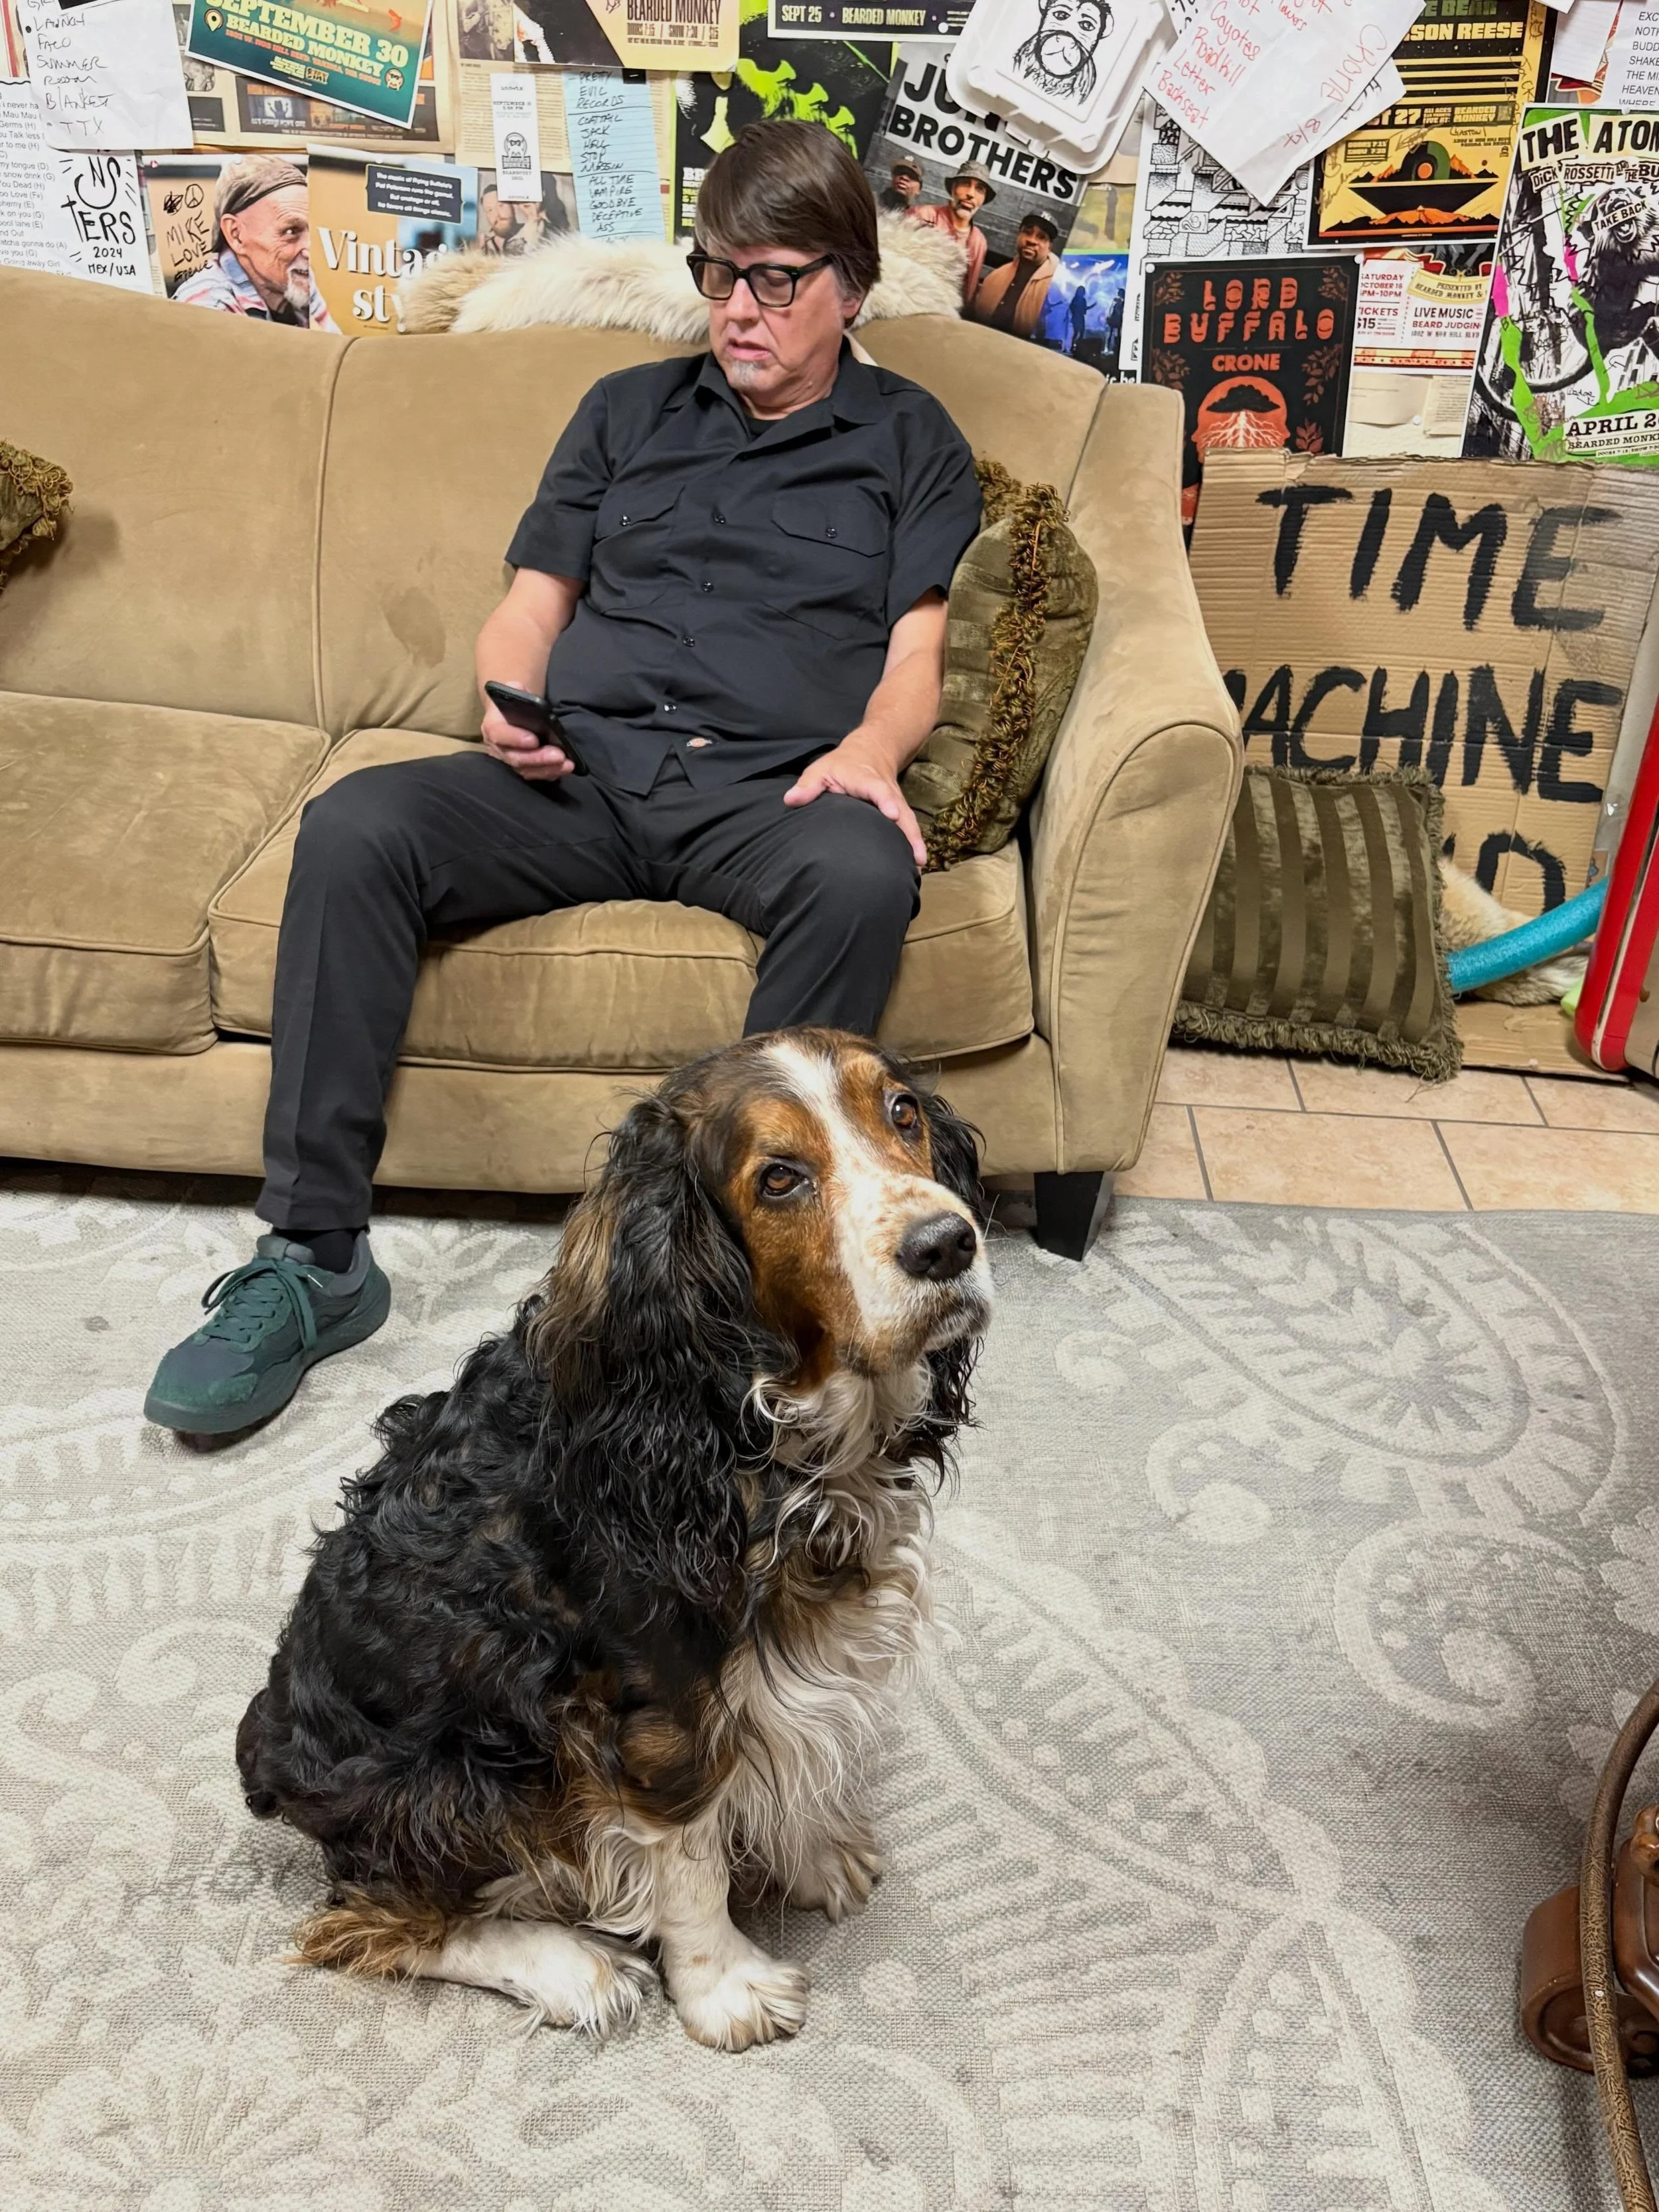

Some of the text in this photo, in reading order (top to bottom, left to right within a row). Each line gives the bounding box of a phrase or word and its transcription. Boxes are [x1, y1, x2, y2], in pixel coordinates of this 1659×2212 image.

[627, 0, 721, 25] BEARDED MONKEY
[782, 5, 926, 27] SEPT 25 BEARDED MONKEY
[1210, 1, 1260, 60] Coyotes
[1403, 22, 1524, 41] SON REESE
[226, 13, 305, 52] BEARDED
[307, 38, 384, 77] MONKEY
[375, 38, 409, 68] 30
[1192, 27, 1247, 87] Roadkill
[1173, 48, 1216, 96] Letter
[1626, 70, 1659, 81] THE MI
[576, 95, 626, 109] RECORDS
[580, 86, 608, 96] EVIL
[1158, 70, 1210, 130] Backseat
[1394, 108, 1421, 125] 27
[581, 125, 610, 139] JACK
[1523, 118, 1579, 163] THE
[889, 104, 1077, 199] BROTHERS
[589, 196, 637, 210] GOODBYE
[1595, 200, 1647, 230] TAKE BACK
[167, 210, 210, 246] MIKE
[93, 246, 122, 258] 2024
[171, 241, 218, 267] LOVE
[88, 263, 135, 276] MEX/USA
[1203, 277, 1297, 311] LORD
[1415, 283, 1443, 297] BEARDED
[1414, 307, 1474, 319] LIVE MUSIC
[1163, 309, 1335, 344] BUFFALO
[1212, 354, 1280, 372] CRONE
[1565, 413, 1659, 436] APRIL 2
[1567, 438, 1620, 450] BEARDED
[1256, 485, 1623, 631] TIME
